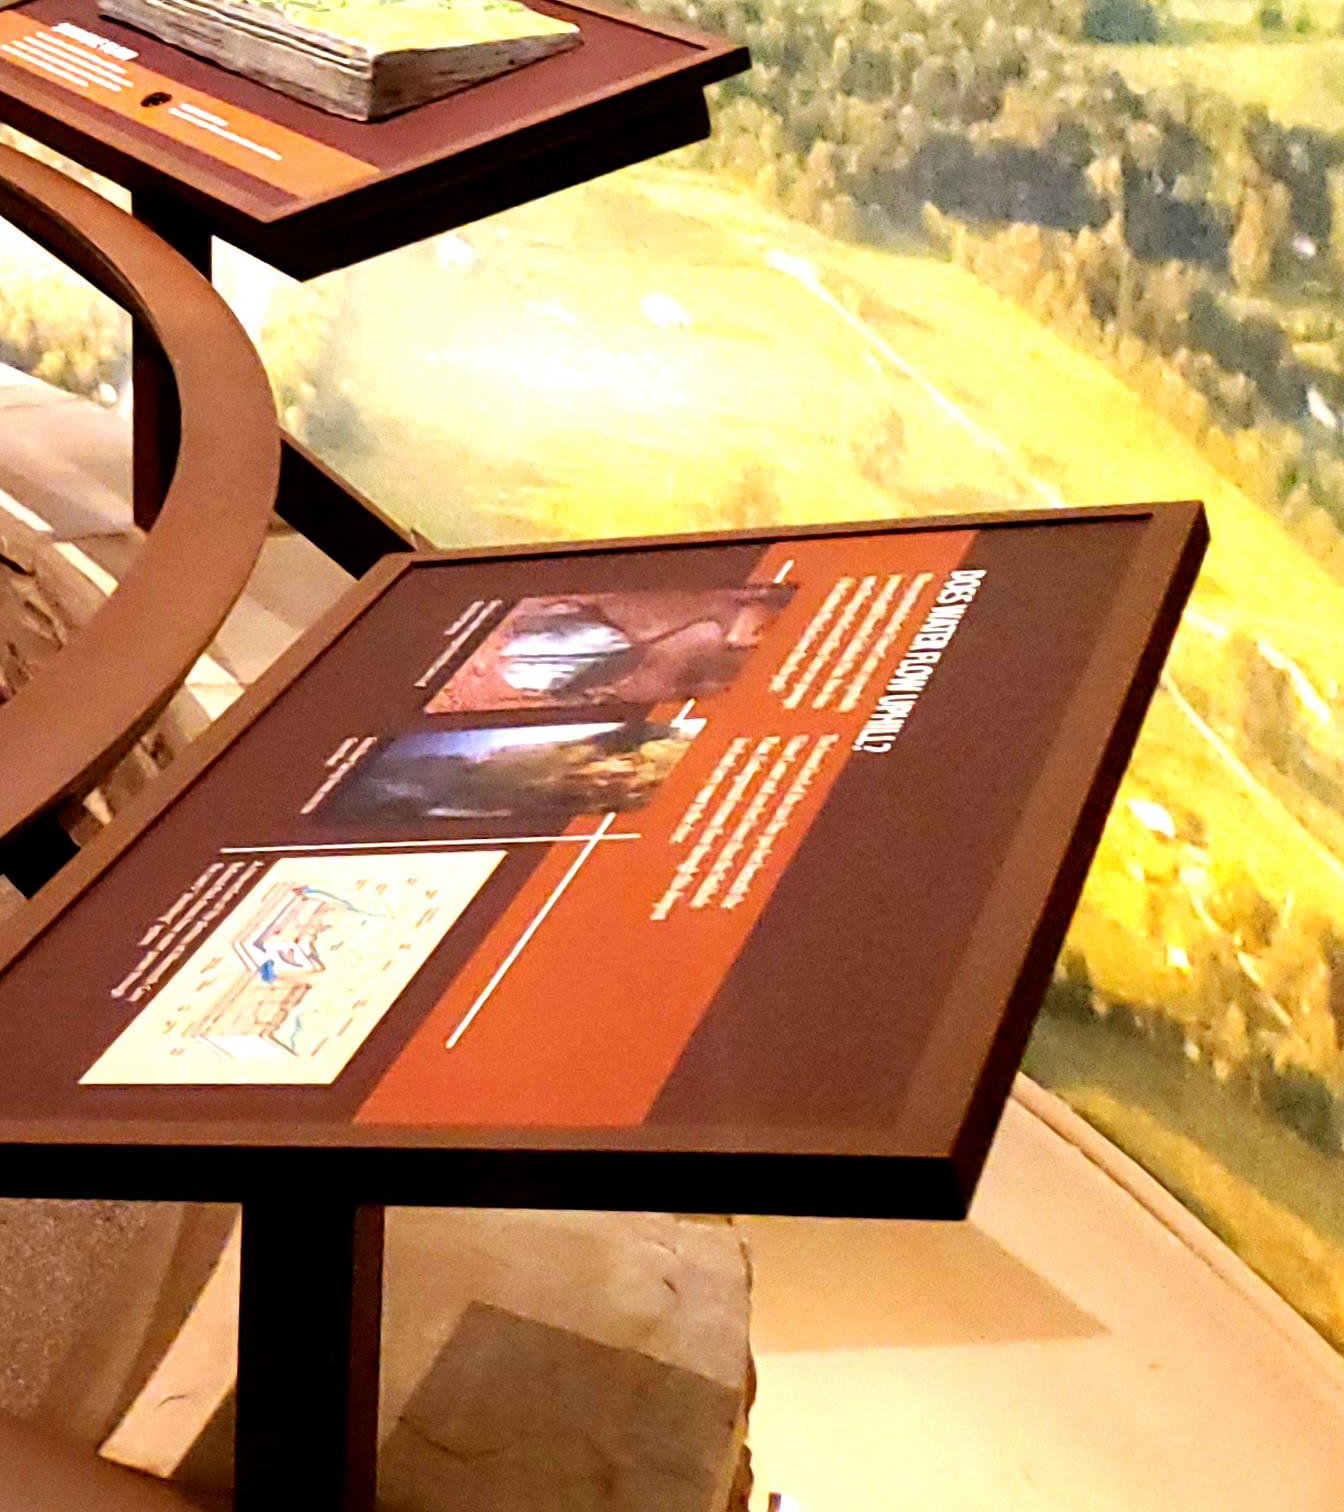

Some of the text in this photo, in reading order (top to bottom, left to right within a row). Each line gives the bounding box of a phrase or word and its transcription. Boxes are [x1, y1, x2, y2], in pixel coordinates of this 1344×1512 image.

[851, 569, 988, 754] DOES WATER FLOW UPHILL?
